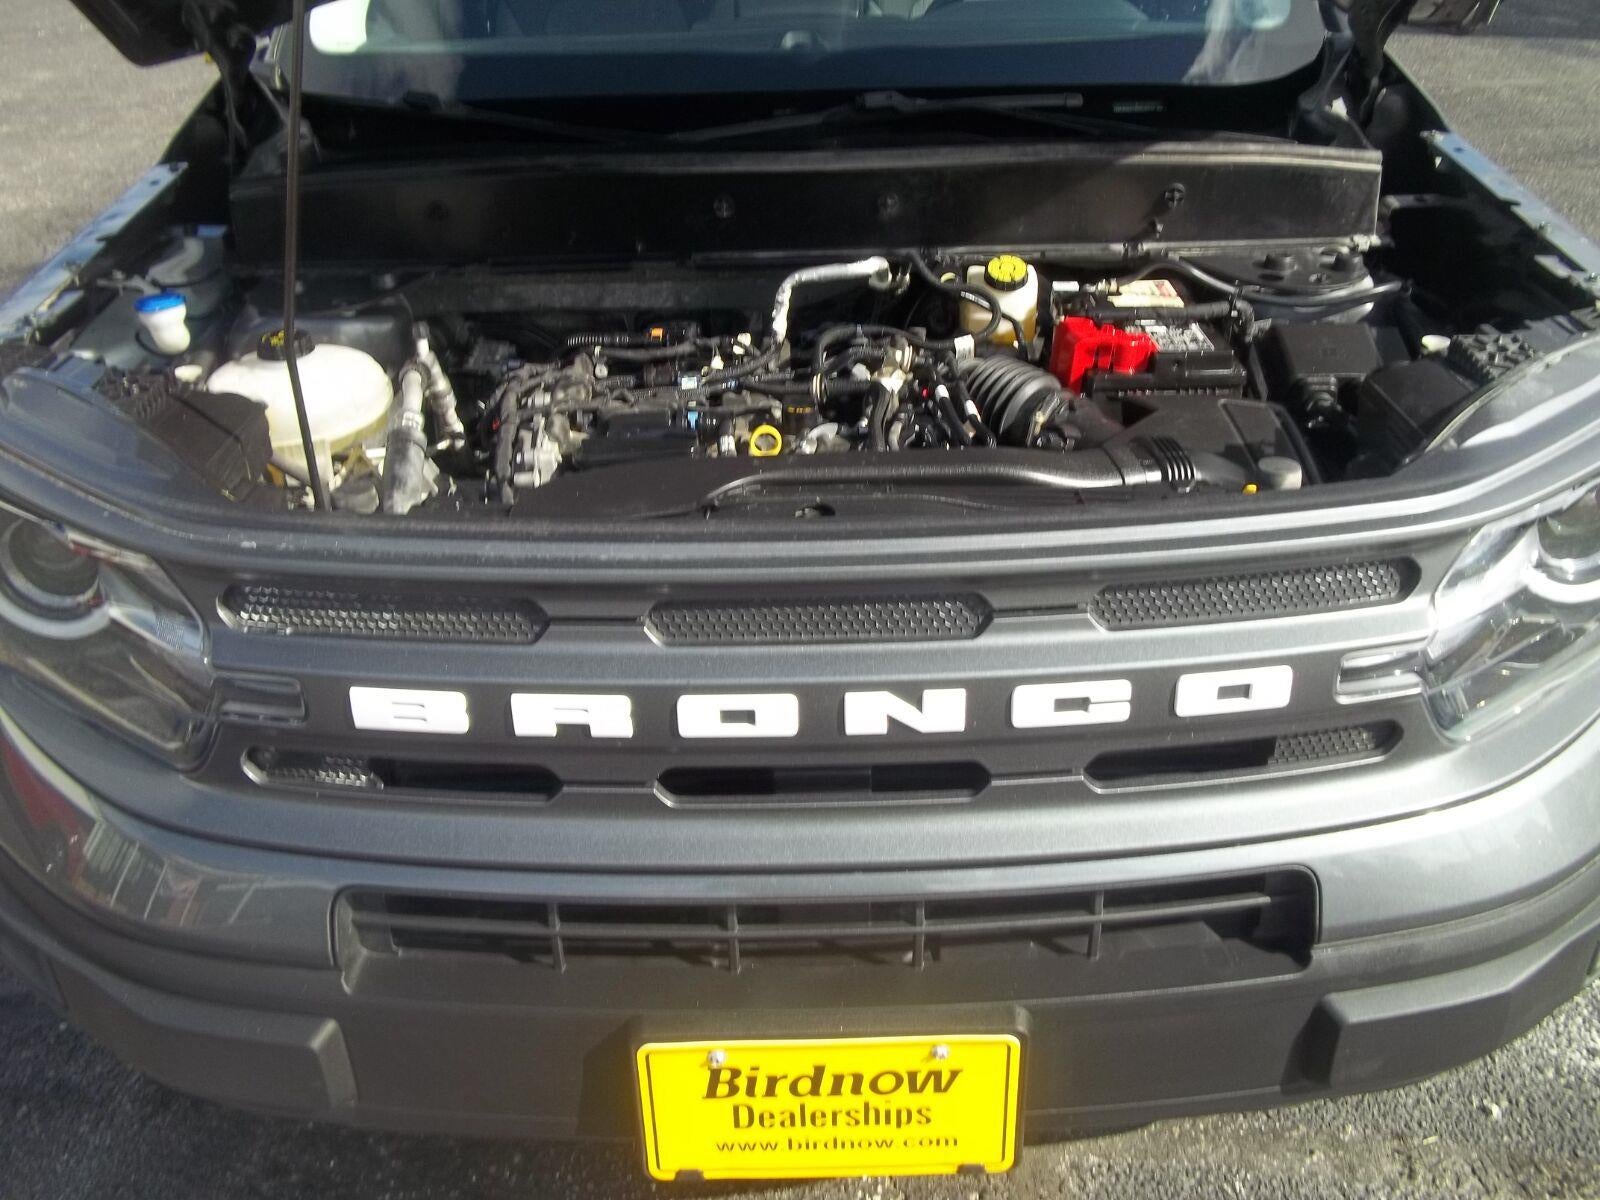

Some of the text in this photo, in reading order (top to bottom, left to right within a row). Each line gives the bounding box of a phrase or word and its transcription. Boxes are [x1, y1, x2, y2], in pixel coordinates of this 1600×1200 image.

[348, 665, 1294, 739] BRONCO
[703, 1065, 962, 1099] Birdnow
[732, 1102, 932, 1129] Dealerships
[716, 1136, 959, 1152] www.birdnow.com
